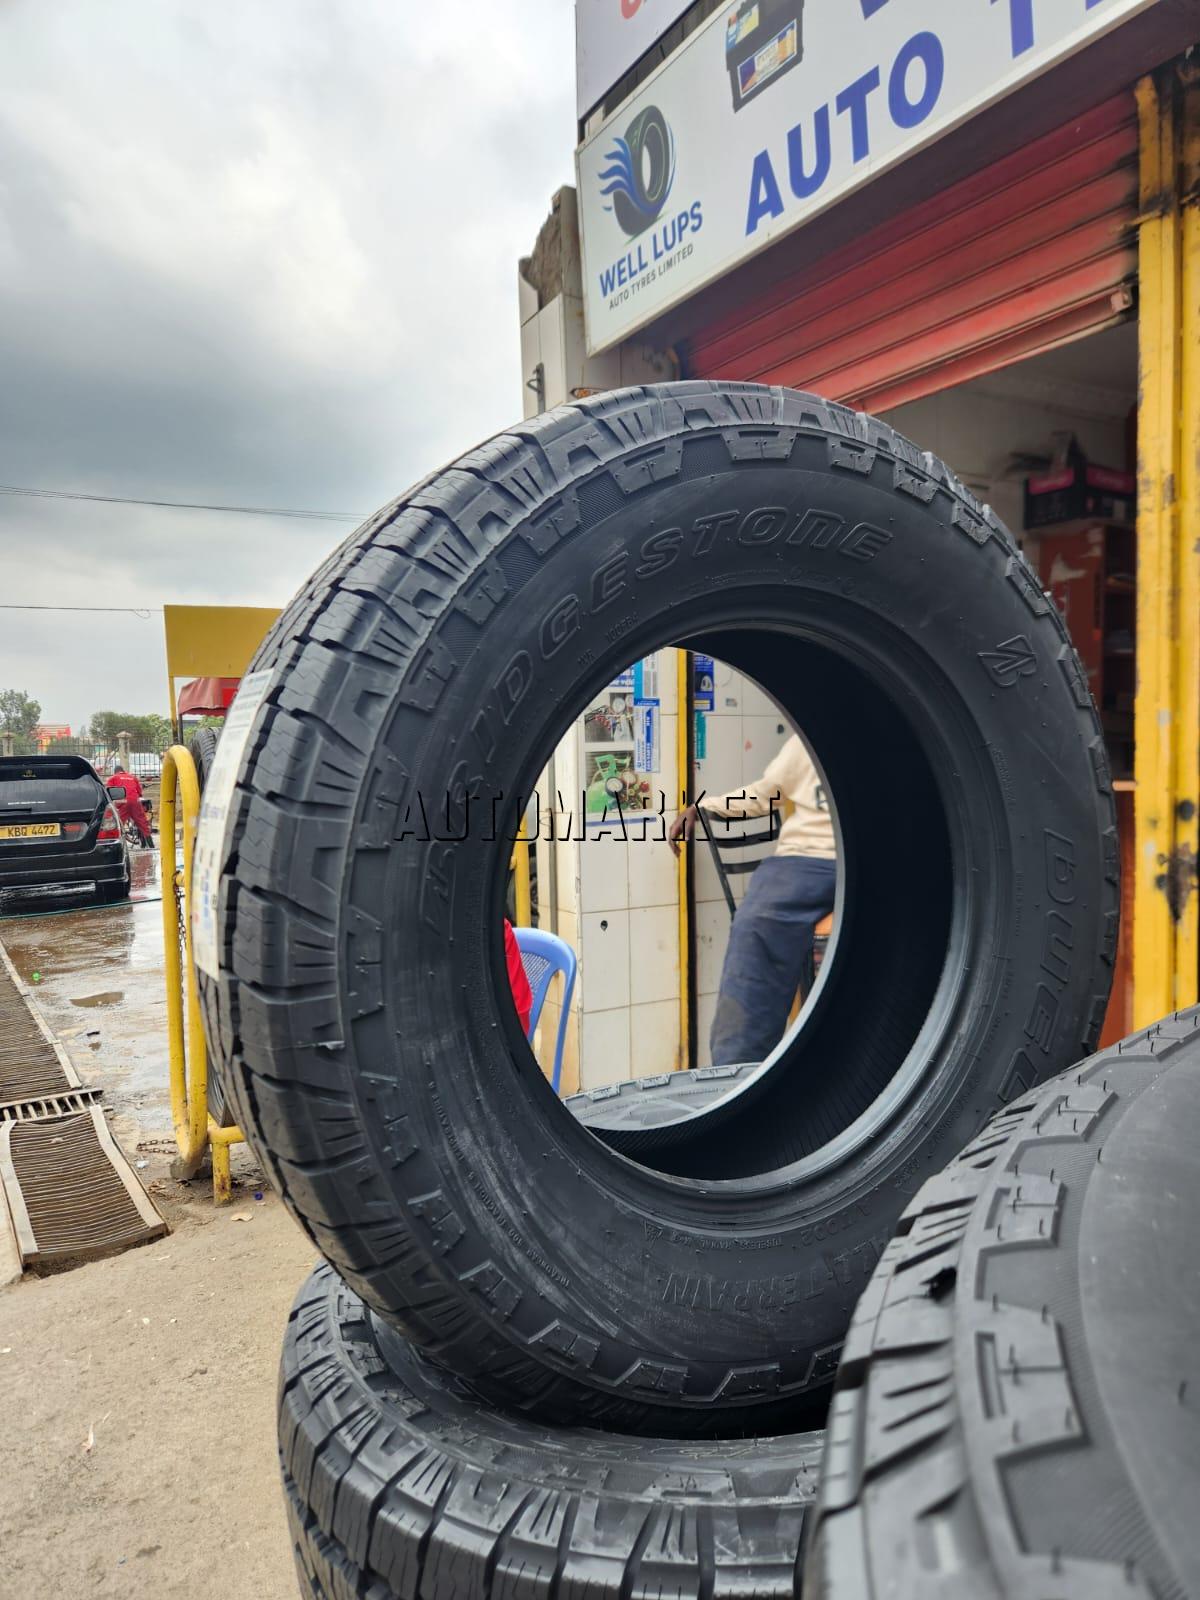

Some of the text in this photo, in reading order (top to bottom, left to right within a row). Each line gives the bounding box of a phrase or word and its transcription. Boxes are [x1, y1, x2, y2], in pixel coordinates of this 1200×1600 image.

[745, 31, 945, 237] AUTO
[599, 200, 703, 298] WELL LUPS
[609, 243, 694, 311] AUTO TYRES LIMITED
[7, 827, 28, 838] KBQ
[996, 829, 1076, 1104] DUEL
